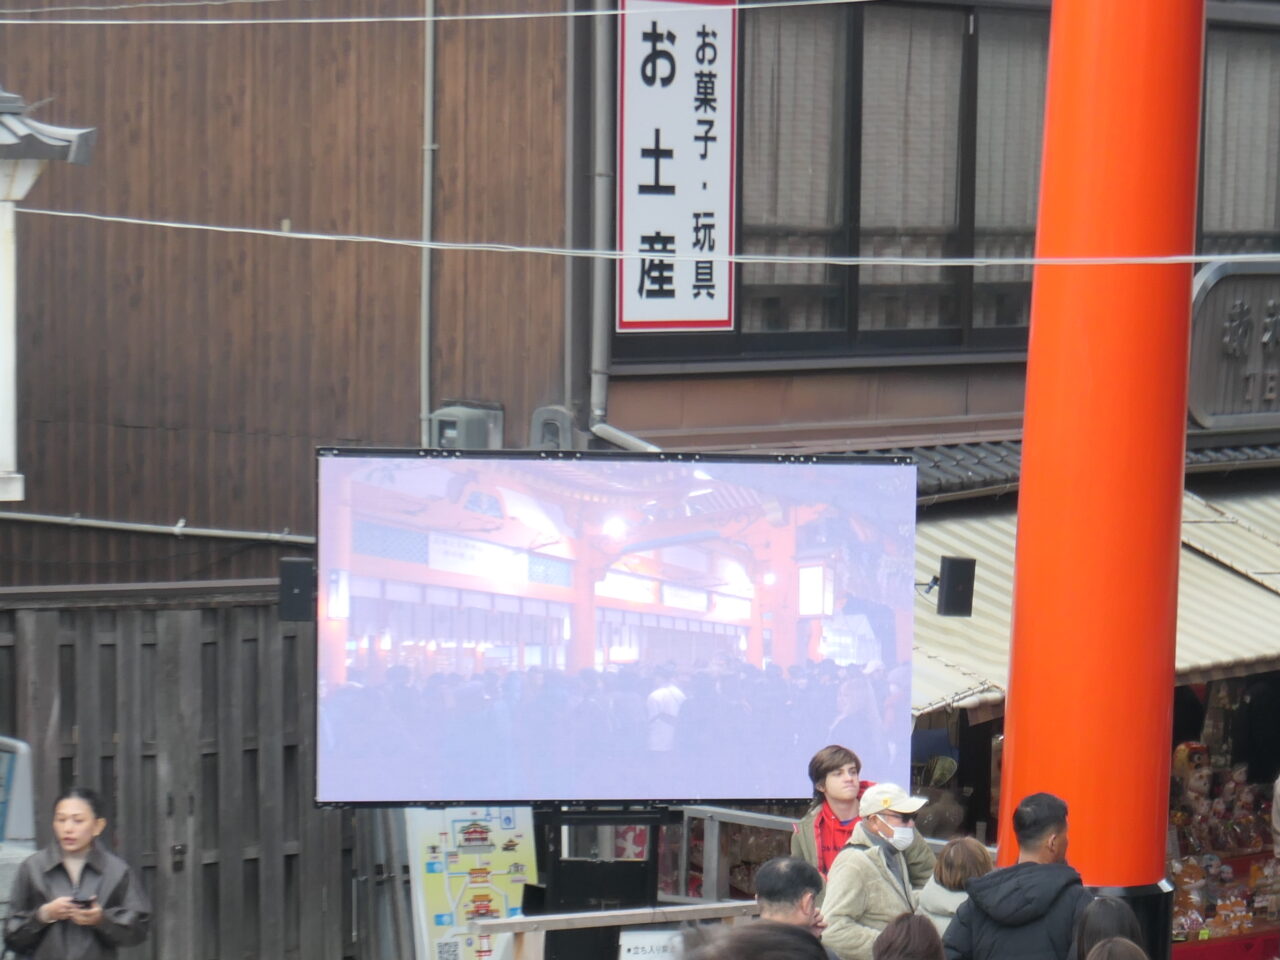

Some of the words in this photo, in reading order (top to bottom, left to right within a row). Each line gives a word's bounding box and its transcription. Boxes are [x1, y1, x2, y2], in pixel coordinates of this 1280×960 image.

[638, 21, 676, 299] お土産
[692, 25, 717, 299] お菓子・玩具
